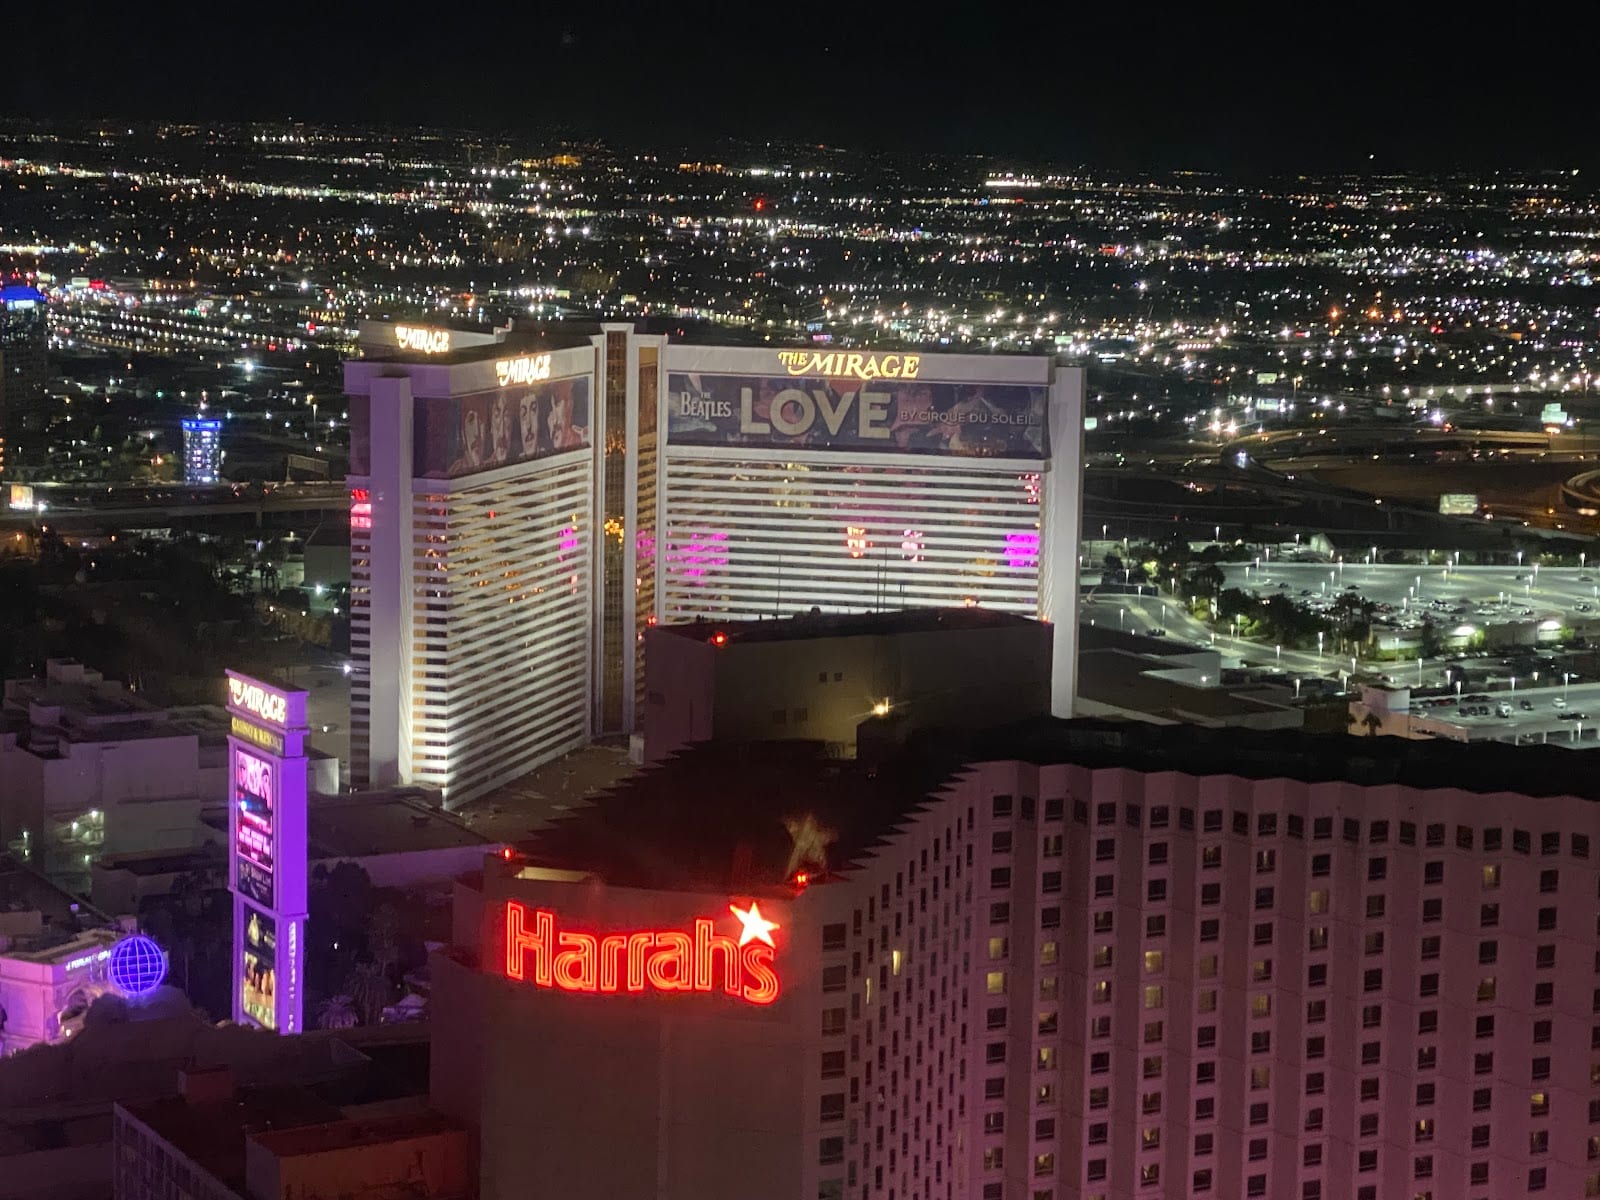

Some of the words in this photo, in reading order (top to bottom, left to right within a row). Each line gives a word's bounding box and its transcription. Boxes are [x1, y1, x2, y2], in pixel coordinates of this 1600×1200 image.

[398, 328, 450, 354] MIRAGE
[499, 355, 552, 387] MIRAGE
[778, 352, 807, 366] THE
[788, 352, 920, 380] MIRAGE
[680, 391, 732, 420] BEATLES
[700, 391, 712, 399] THE
[740, 387, 892, 439] LOVE
[900, 410, 917, 421] BY
[918, 410, 966, 424] CIRQUE
[969, 413, 987, 424] DU
[991, 414, 1036, 425] SOLEIL
[233, 682, 286, 723] MIRAGE
